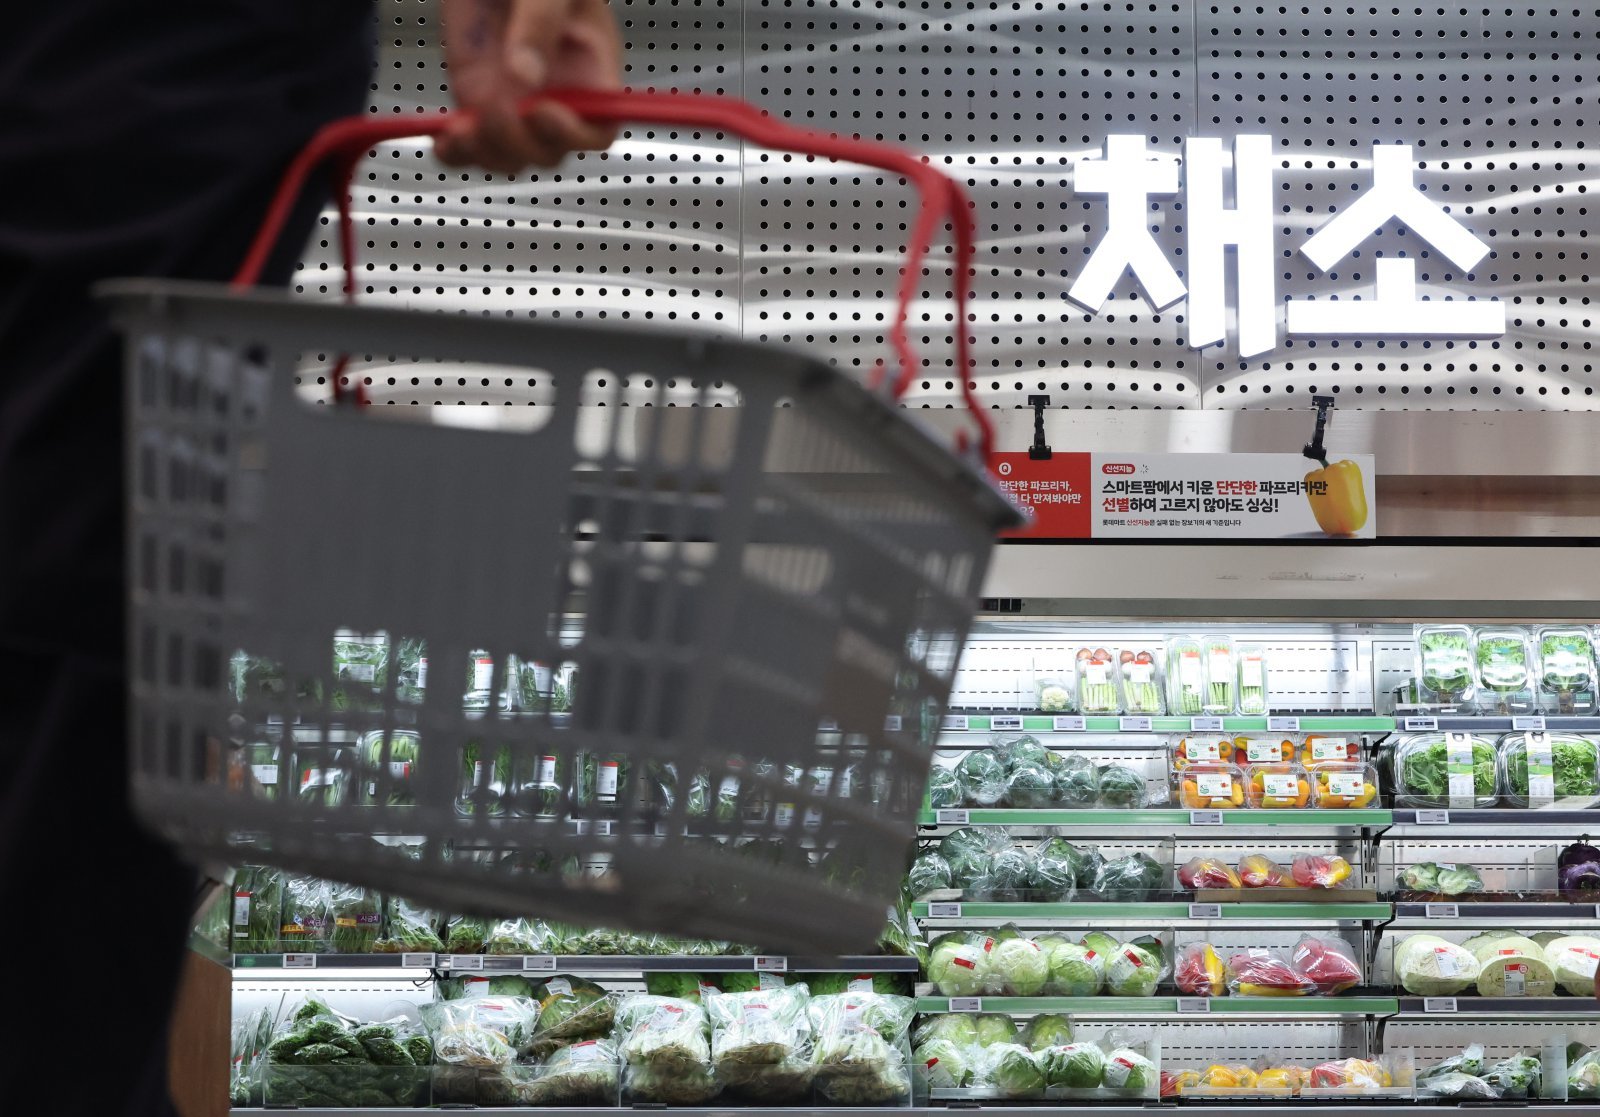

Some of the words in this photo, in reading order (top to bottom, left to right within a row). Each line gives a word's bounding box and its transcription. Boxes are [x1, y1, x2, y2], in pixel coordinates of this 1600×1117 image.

[1065, 133, 1506, 359] 채소
[1105, 465, 1133, 473] 신선지능
[999, 481, 1028, 491] 단단한
[1030, 481, 1072, 492] 파프리카,
[1102, 480, 1183, 495] 스마트팜에서
[1187, 480, 1214, 495] 키운
[1216, 480, 1257, 495] 단단한
[1259, 480, 1328, 495] 파프리카만
[1020, 494, 1031, 503] 다
[1102, 498, 1156, 512] 선별하여
[1159, 498, 1200, 512] 고르지
[1203, 498, 1244, 512] 않아도
[1246, 498, 1279, 512] 싱싱!
